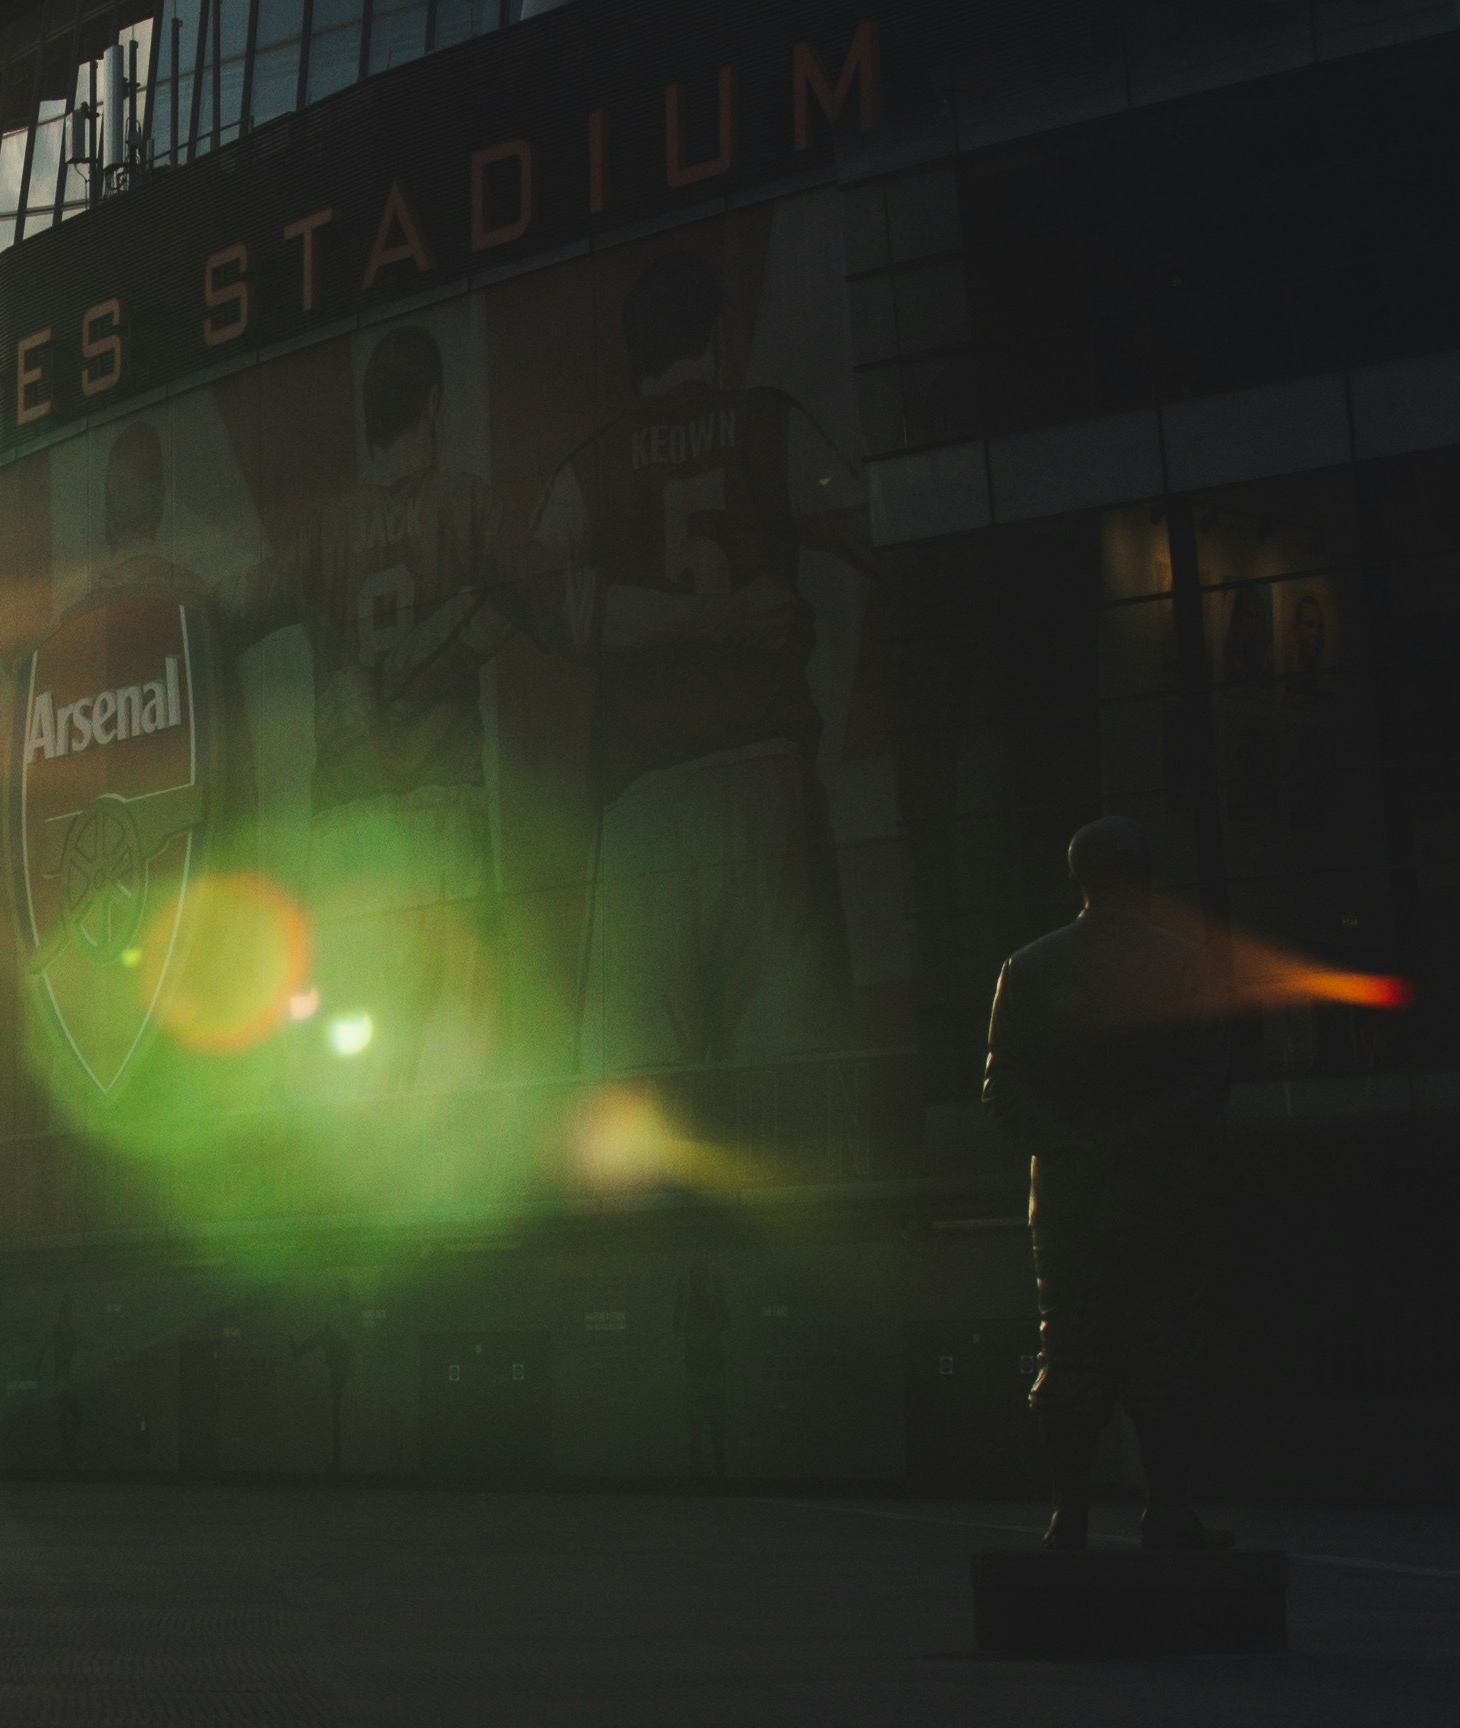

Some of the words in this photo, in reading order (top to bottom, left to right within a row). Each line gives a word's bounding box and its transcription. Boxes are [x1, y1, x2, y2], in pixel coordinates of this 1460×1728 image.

[204, 22, 879, 347] STADIUM
[631, 408, 737, 469] KEOWN
[664, 467, 731, 594] 5
[26, 657, 180, 764] Arsenal
